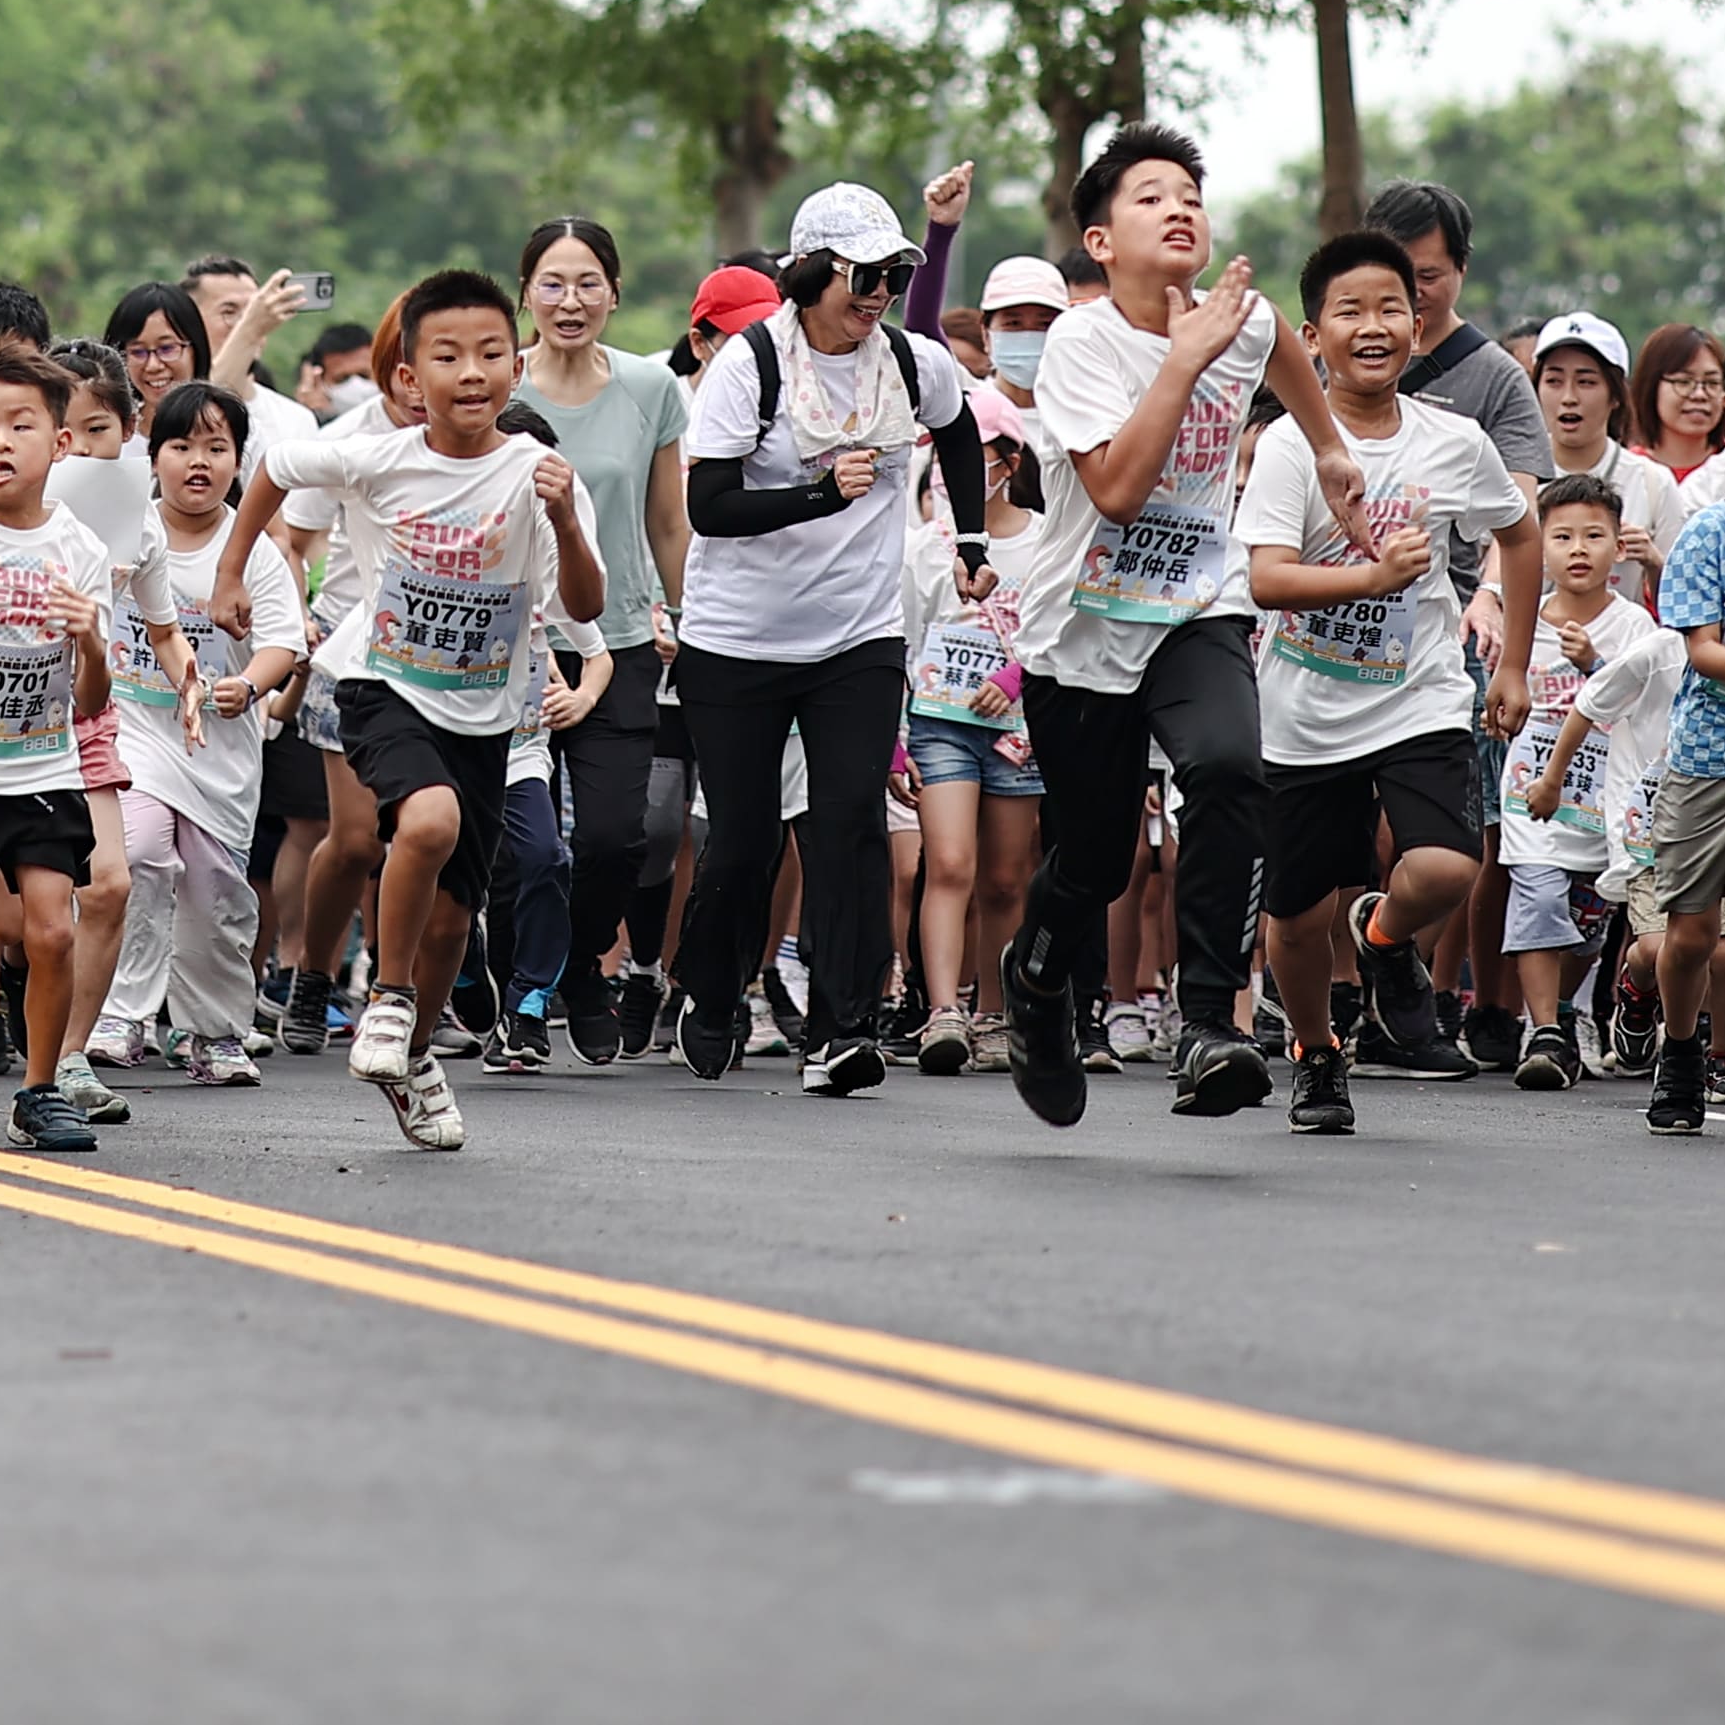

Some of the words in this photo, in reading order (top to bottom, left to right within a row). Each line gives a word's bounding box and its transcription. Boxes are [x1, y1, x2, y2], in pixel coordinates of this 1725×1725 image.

[1176, 427, 1230, 449] FOR
[1173, 451, 1227, 474] MOM
[413, 522, 485, 548] RUN
[1121, 526, 1200, 557] Y0782
[411, 543, 483, 570] FOR
[1113, 549, 1190, 584] 鄭仲岳
[404, 593, 492, 629] Y0779
[943, 666, 985, 690] 蔡喬
